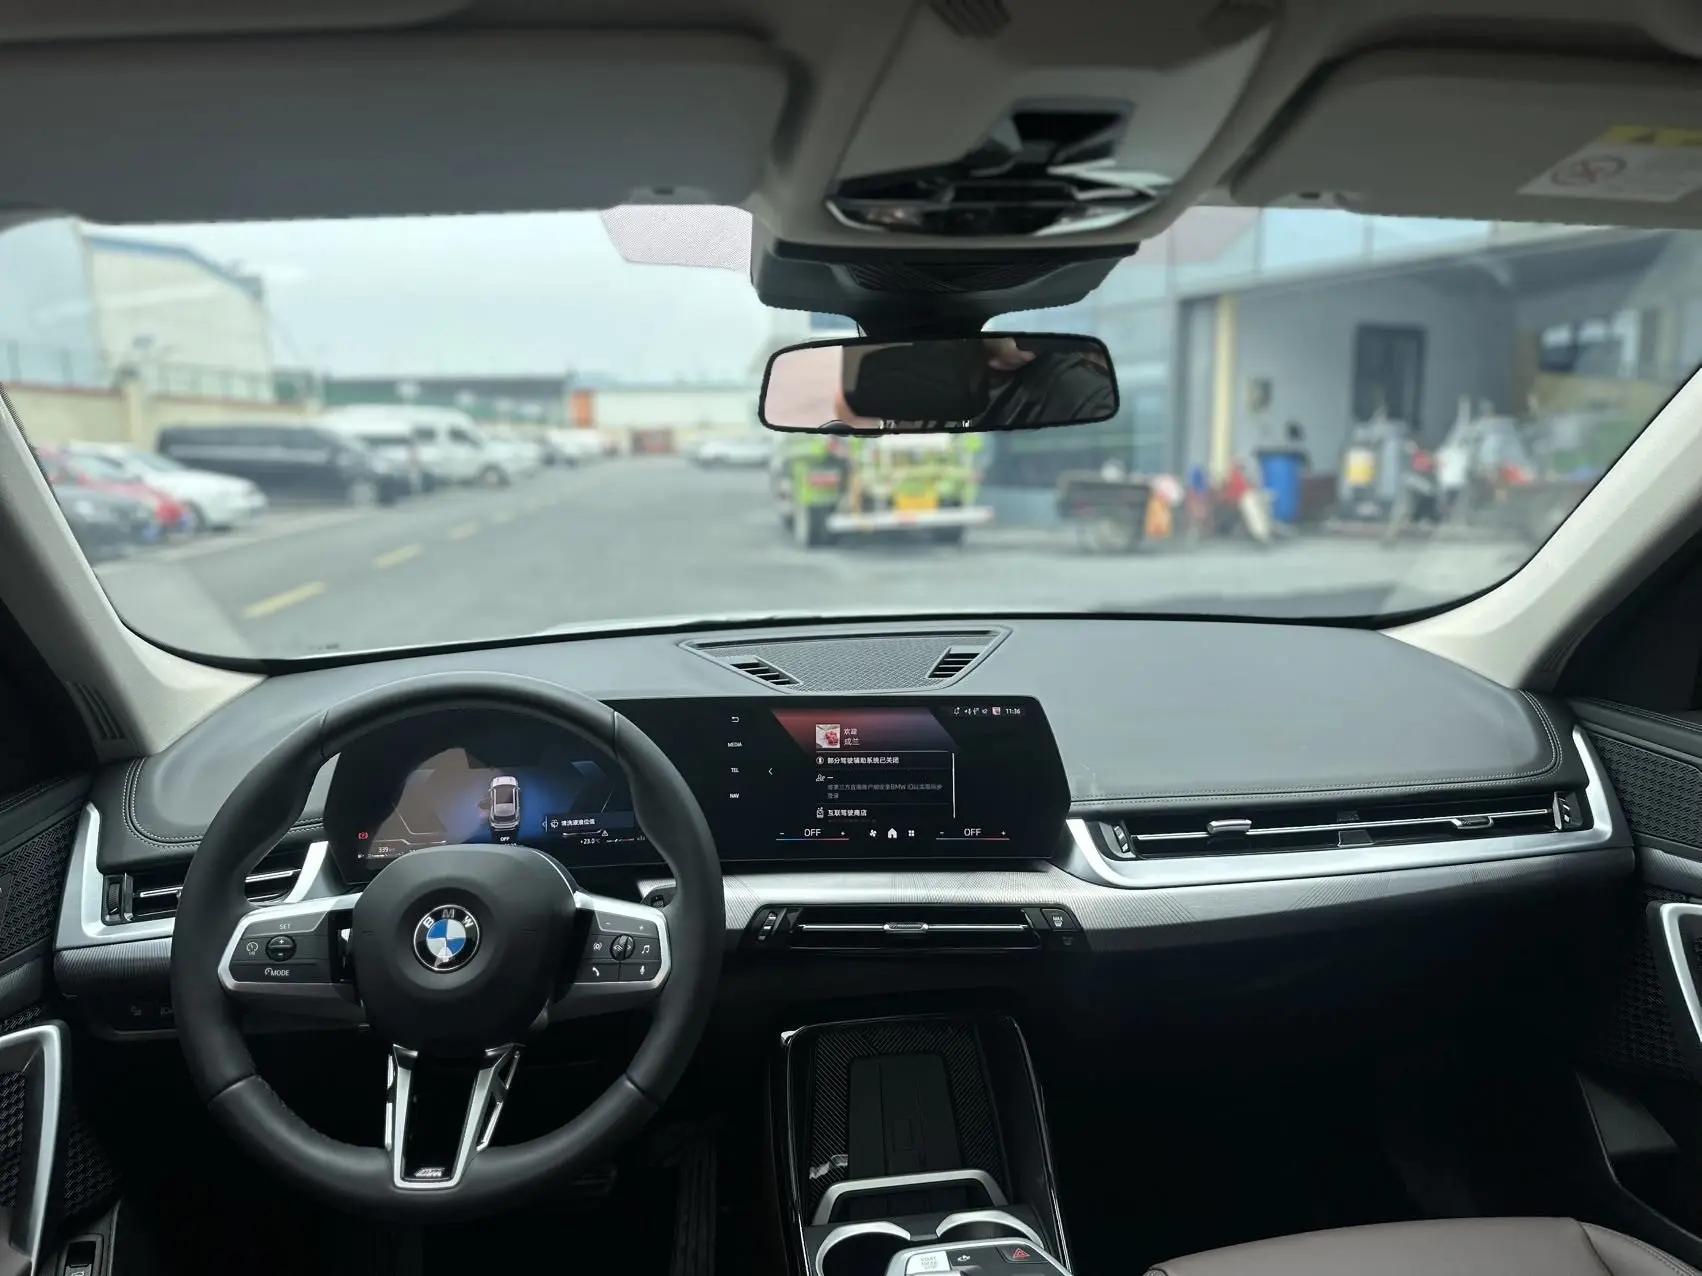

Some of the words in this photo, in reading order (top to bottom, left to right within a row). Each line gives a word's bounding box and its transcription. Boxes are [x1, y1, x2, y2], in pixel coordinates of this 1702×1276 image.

[804, 828, 821, 837] OFF
[963, 828, 982, 837] OFF
[422, 908, 474, 929] BMW
